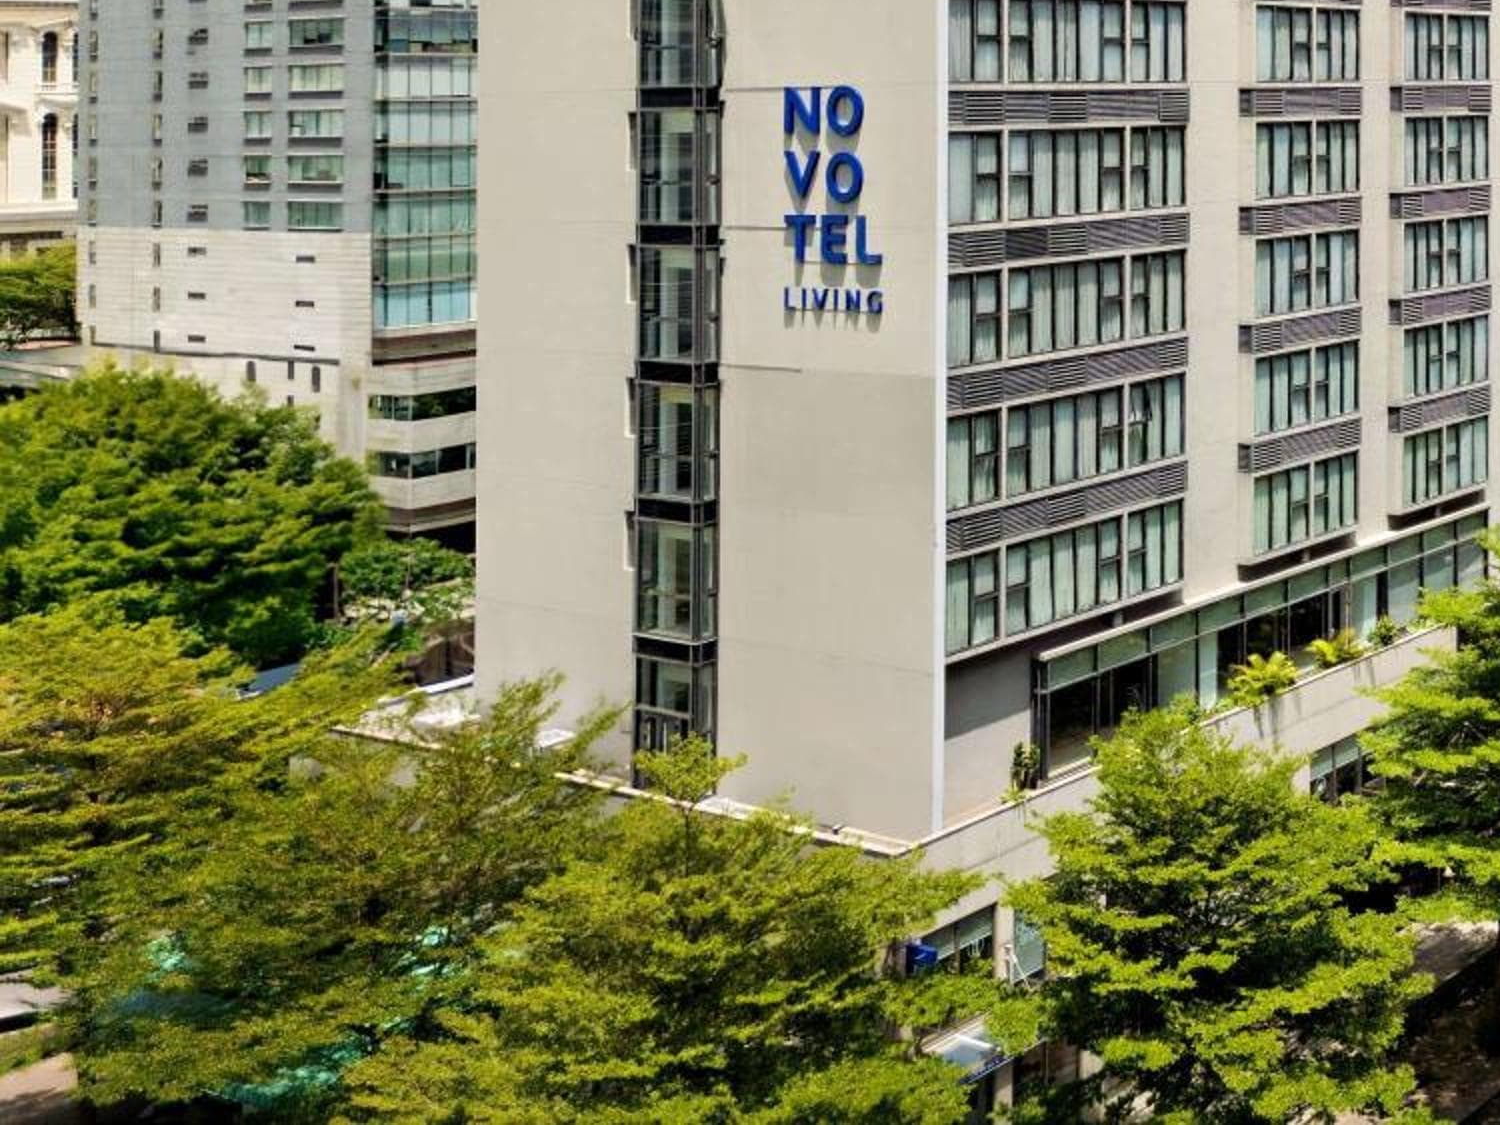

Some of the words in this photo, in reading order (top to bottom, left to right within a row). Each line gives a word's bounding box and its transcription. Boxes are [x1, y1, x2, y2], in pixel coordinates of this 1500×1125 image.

[783, 85, 864, 137] NO
[783, 149, 864, 204] VO
[783, 214, 882, 266] TEL
[783, 286, 883, 315] LIVING
